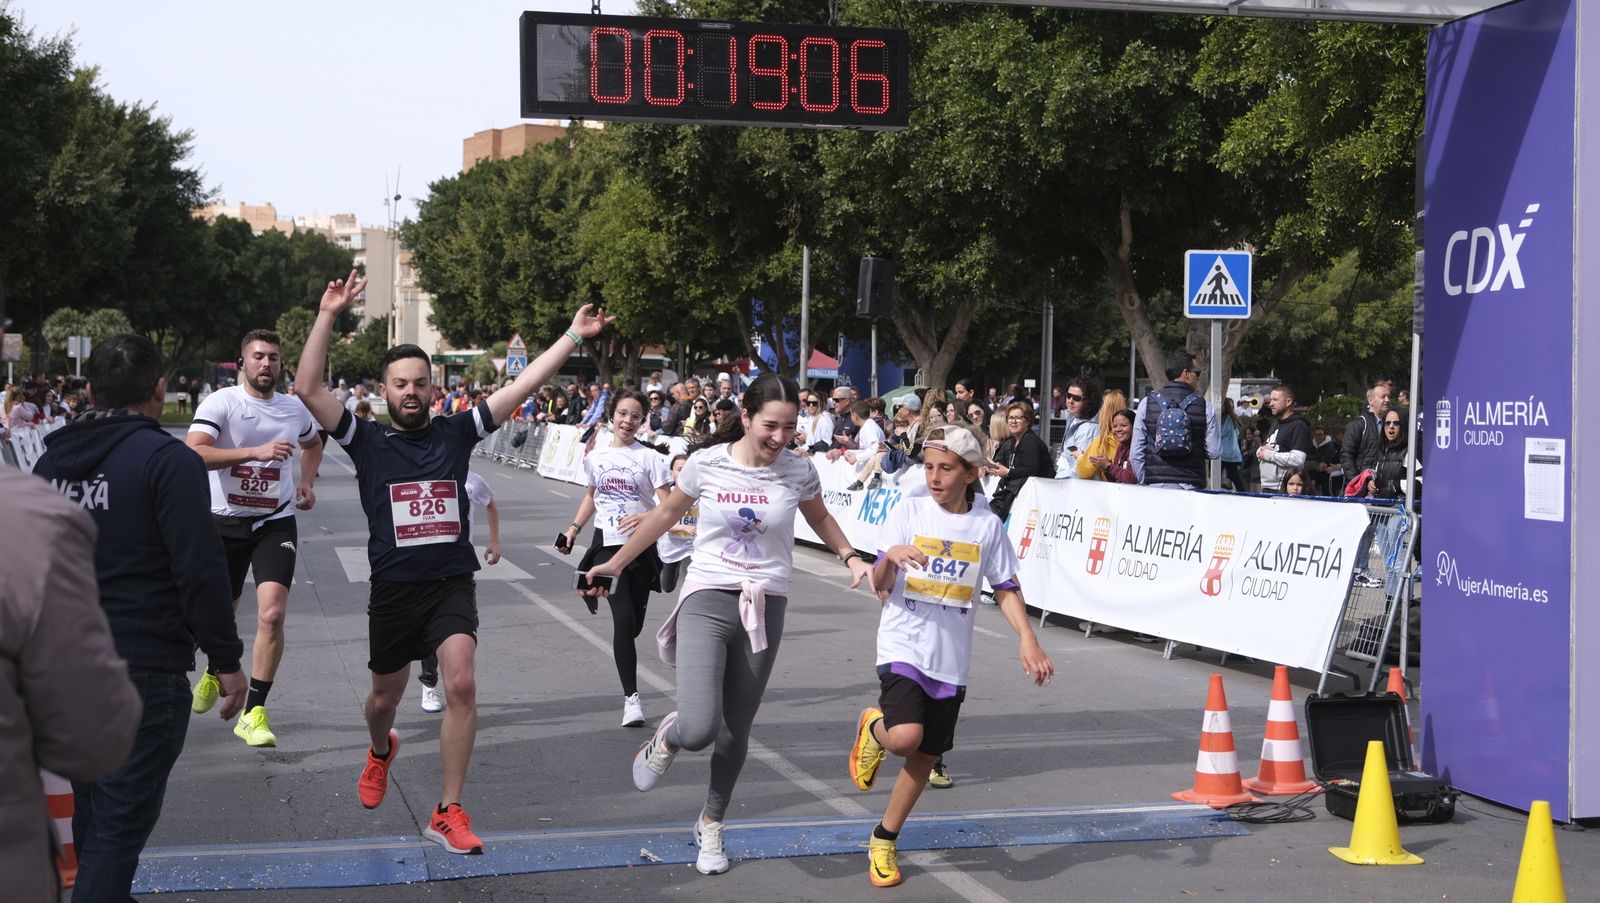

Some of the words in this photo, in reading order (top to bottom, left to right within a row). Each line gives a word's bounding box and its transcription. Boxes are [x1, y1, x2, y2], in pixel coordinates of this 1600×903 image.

[590, 26, 890, 115] 00:19:06
[1444, 204, 1540, 296] CDX
[1463, 395, 1549, 426] ALMERÍA
[1463, 430, 1504, 446] CIUDAD
[240, 479, 269, 492] 820
[717, 493, 769, 504] MUJER
[409, 498, 446, 517] 826
[1121, 523, 1203, 563] ALMERÍA
[1117, 557, 1158, 581] CIUDAD
[1243, 538, 1344, 579] ALMERÍA
[1241, 575, 1289, 601] CIUDAD
